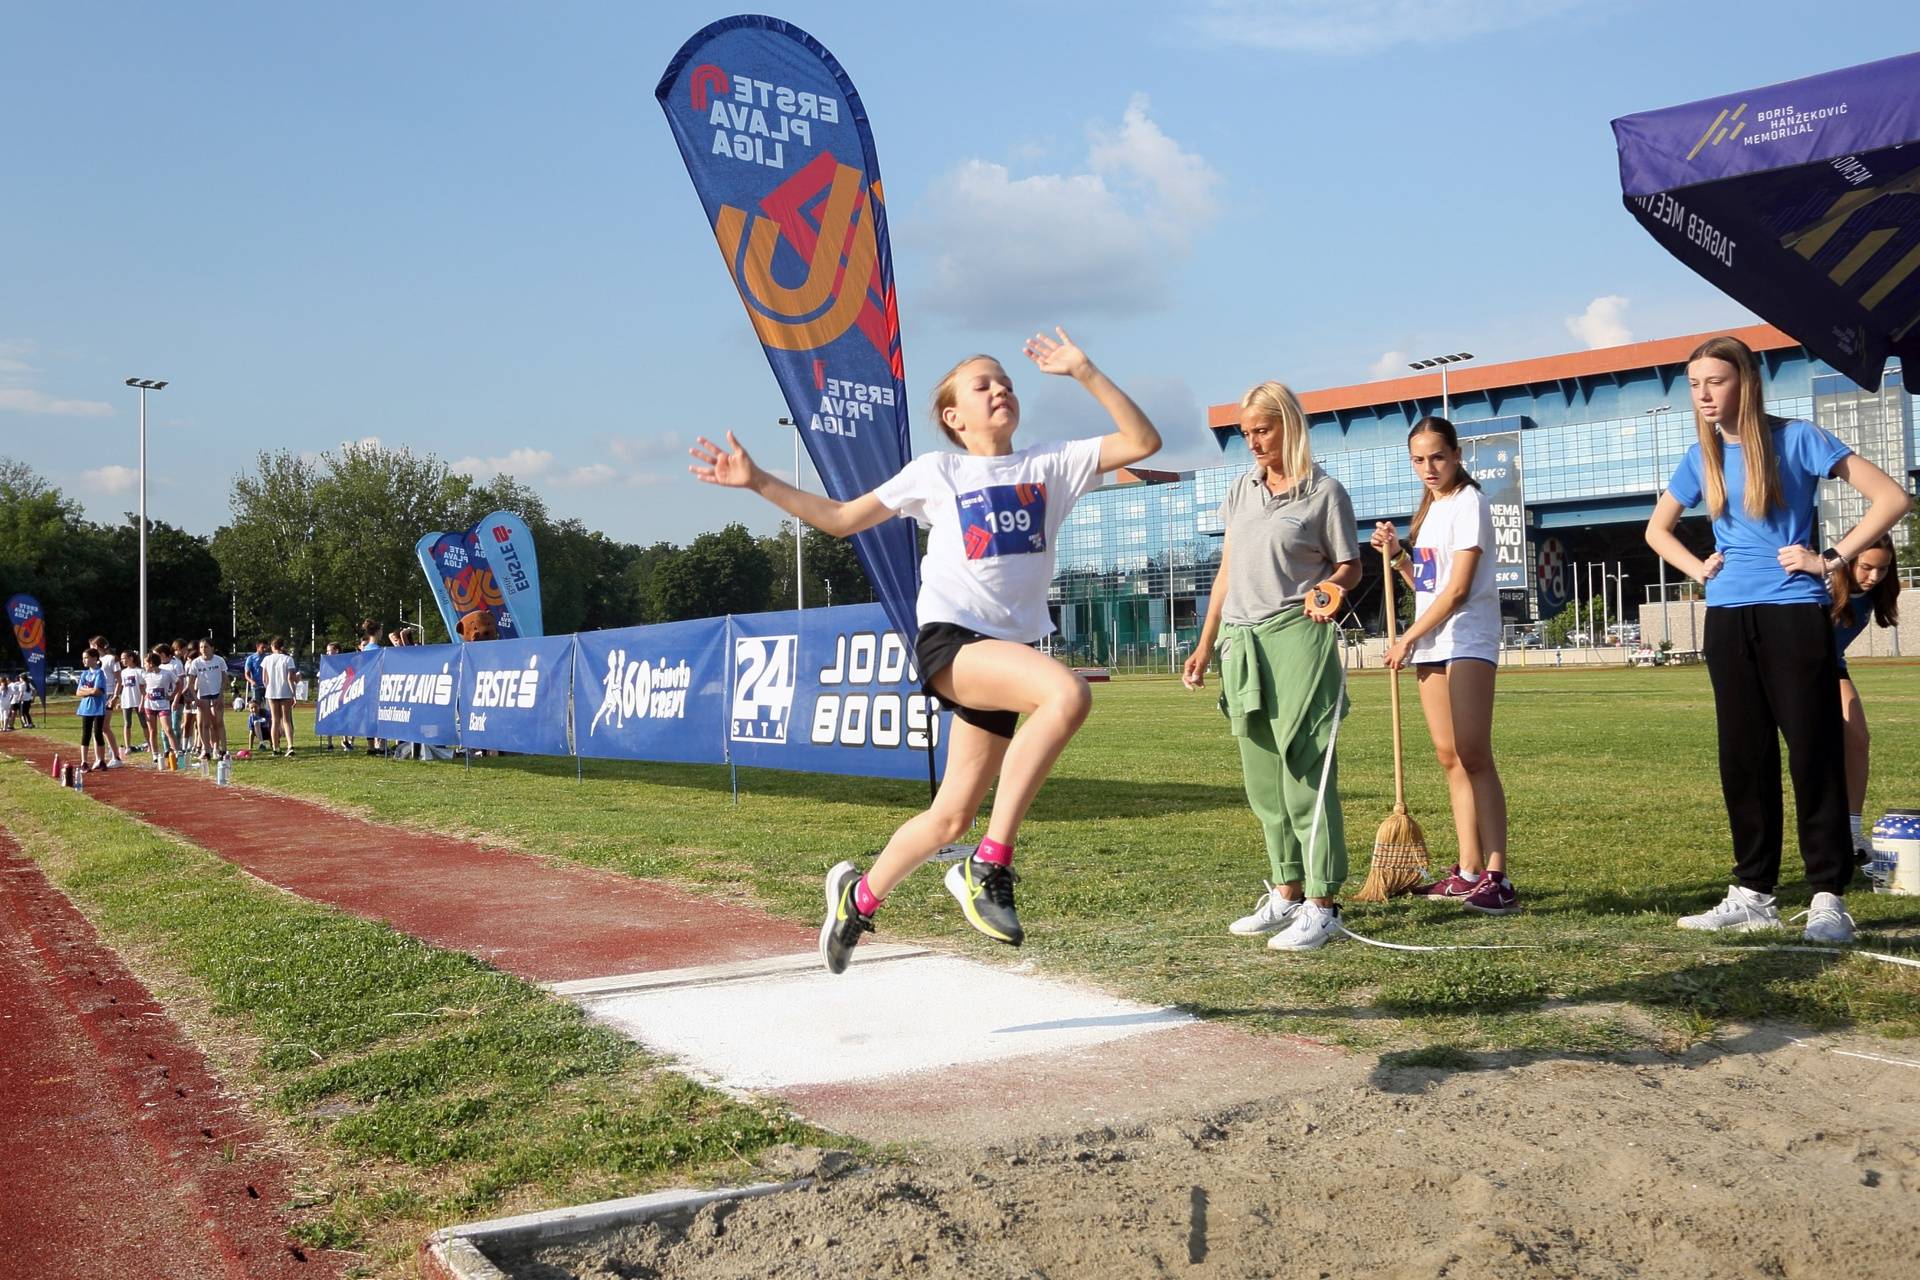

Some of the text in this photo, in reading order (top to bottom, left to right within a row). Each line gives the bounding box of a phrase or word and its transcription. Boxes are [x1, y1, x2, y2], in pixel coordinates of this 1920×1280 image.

[1757, 106, 1794, 122] BORIS
[1743, 123, 1814, 146] MEMORIJAL
[1490, 504, 1521, 516] NEMA
[985, 509, 1031, 534] 199
[1491, 515, 1522, 528] DAJE!
[1495, 527, 1522, 546] MO
[1495, 546, 1523, 564] AJ.
[1495, 572, 1510, 581] SK
[819, 632, 918, 684] JOO
[402, 674, 437, 704] PLAVI
[472, 671, 521, 708] ERSTE
[623, 660, 650, 718] 60
[735, 639, 795, 720] 24
[469, 711, 487, 731] Bank
[733, 721, 784, 737] SATA
